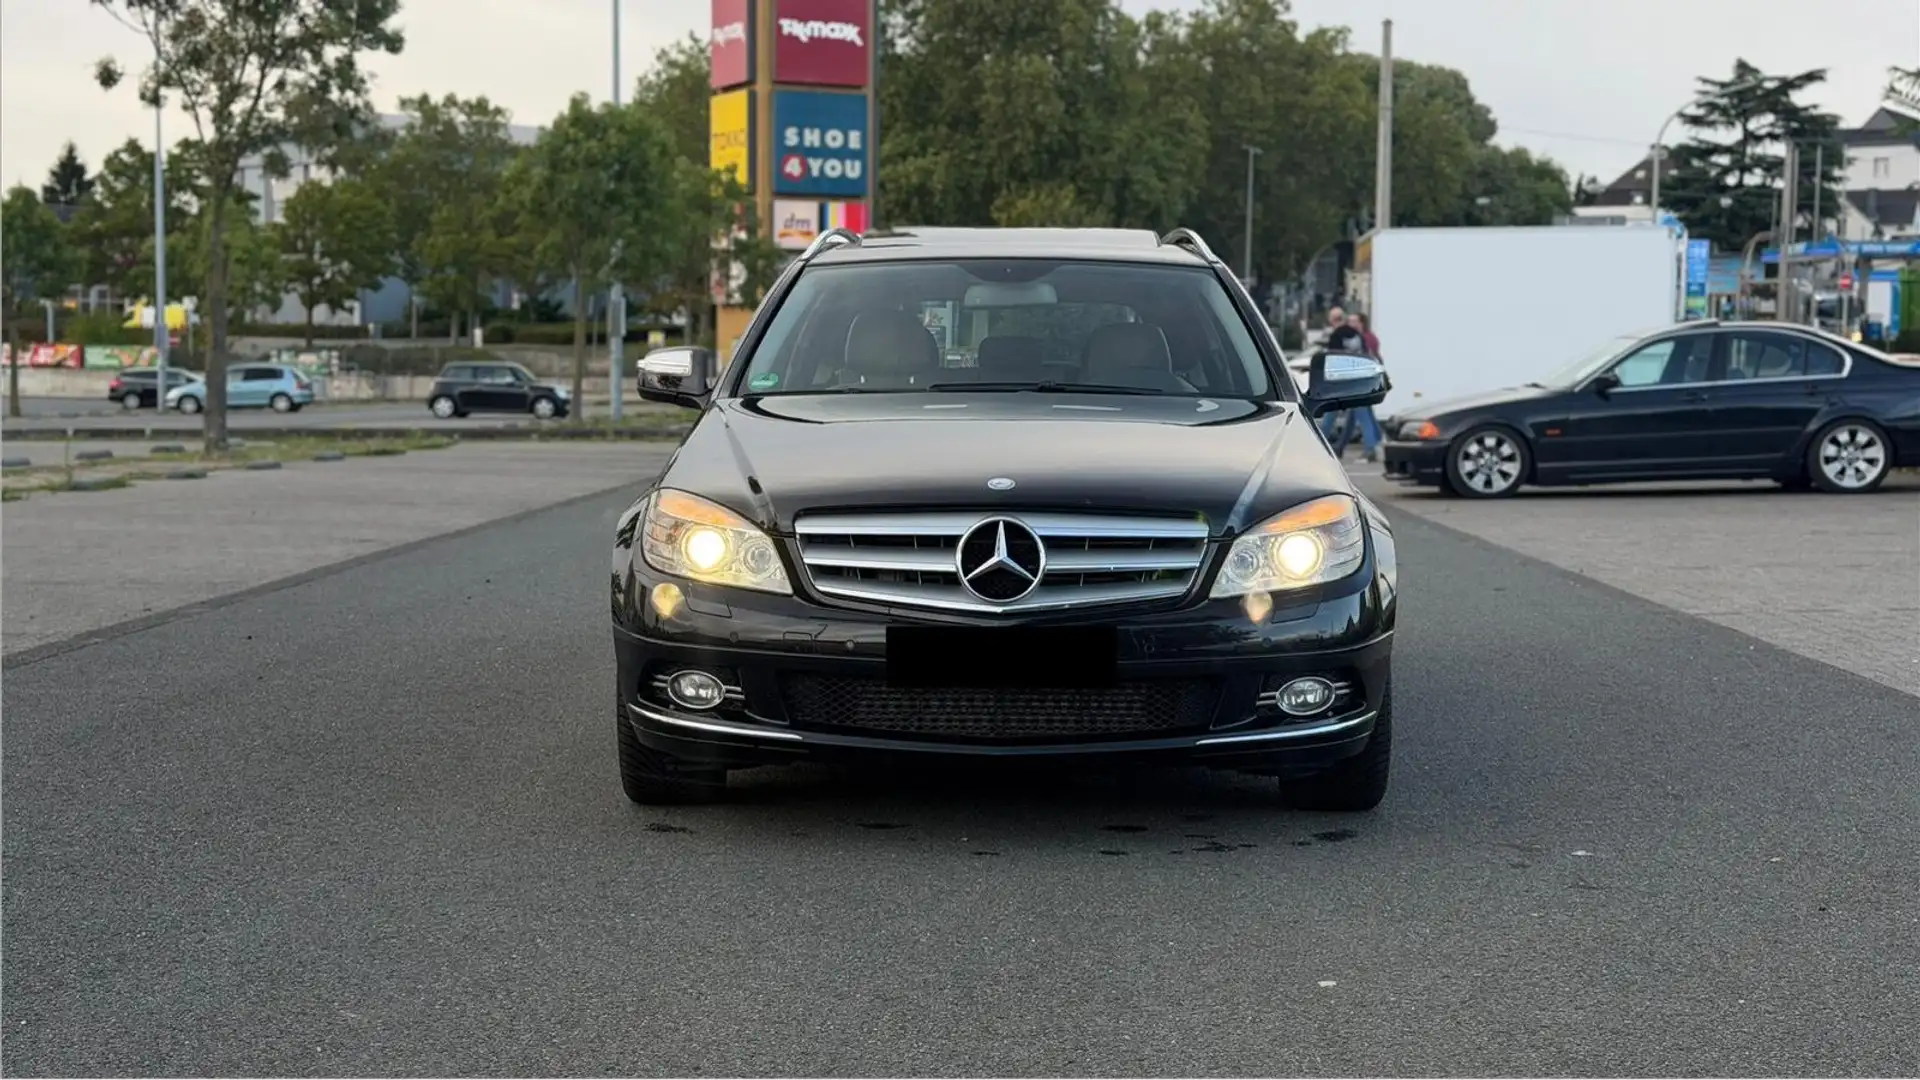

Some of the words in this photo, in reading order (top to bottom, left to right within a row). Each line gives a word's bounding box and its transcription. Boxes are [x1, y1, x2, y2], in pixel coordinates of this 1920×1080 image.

[784, 126, 862, 149] SHOE
[783, 157, 803, 177] 4
[807, 157, 862, 179] YOU
[783, 212, 811, 230] dm
